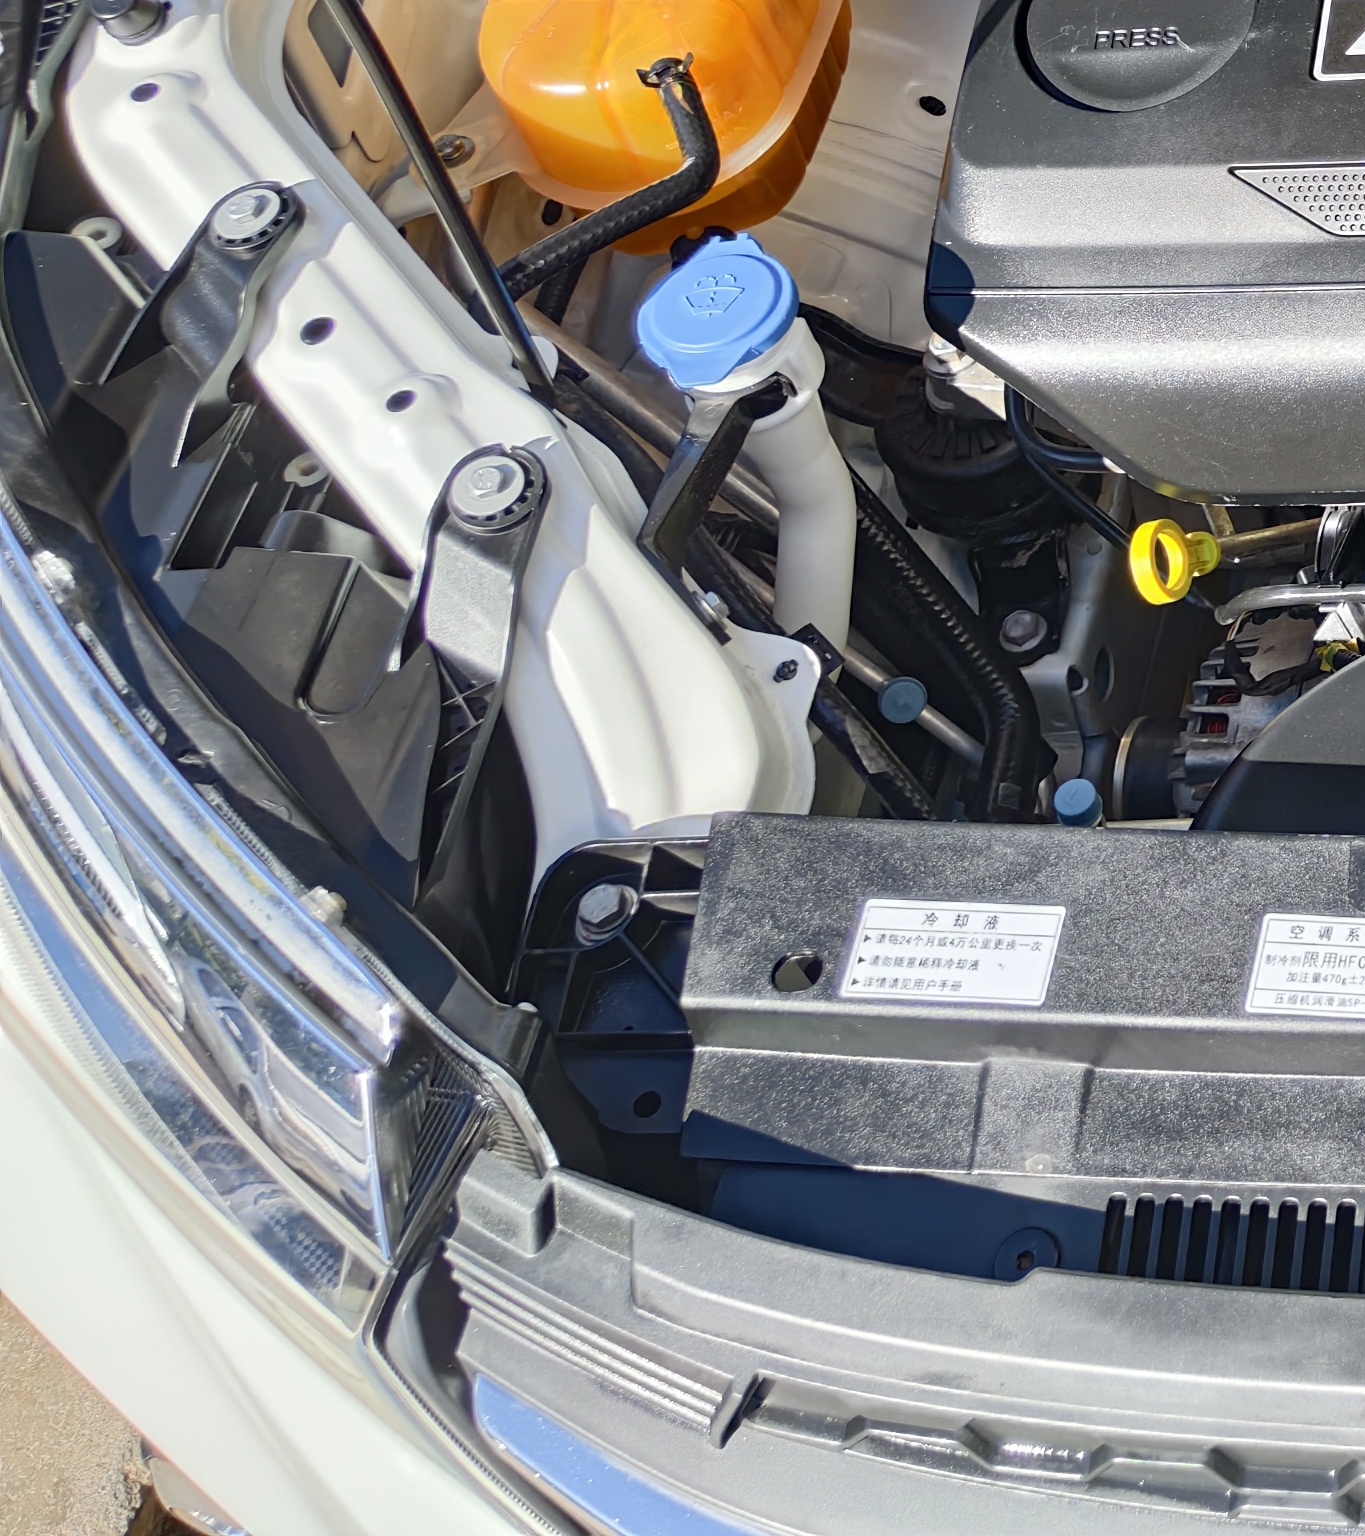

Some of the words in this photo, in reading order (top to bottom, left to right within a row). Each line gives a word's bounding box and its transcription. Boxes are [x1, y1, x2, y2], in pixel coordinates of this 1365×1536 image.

[1094, 26, 1179, 49] PRESS
[922, 912, 1000, 930] 冷却液
[863, 978, 962, 992] 详情请见用户手册
